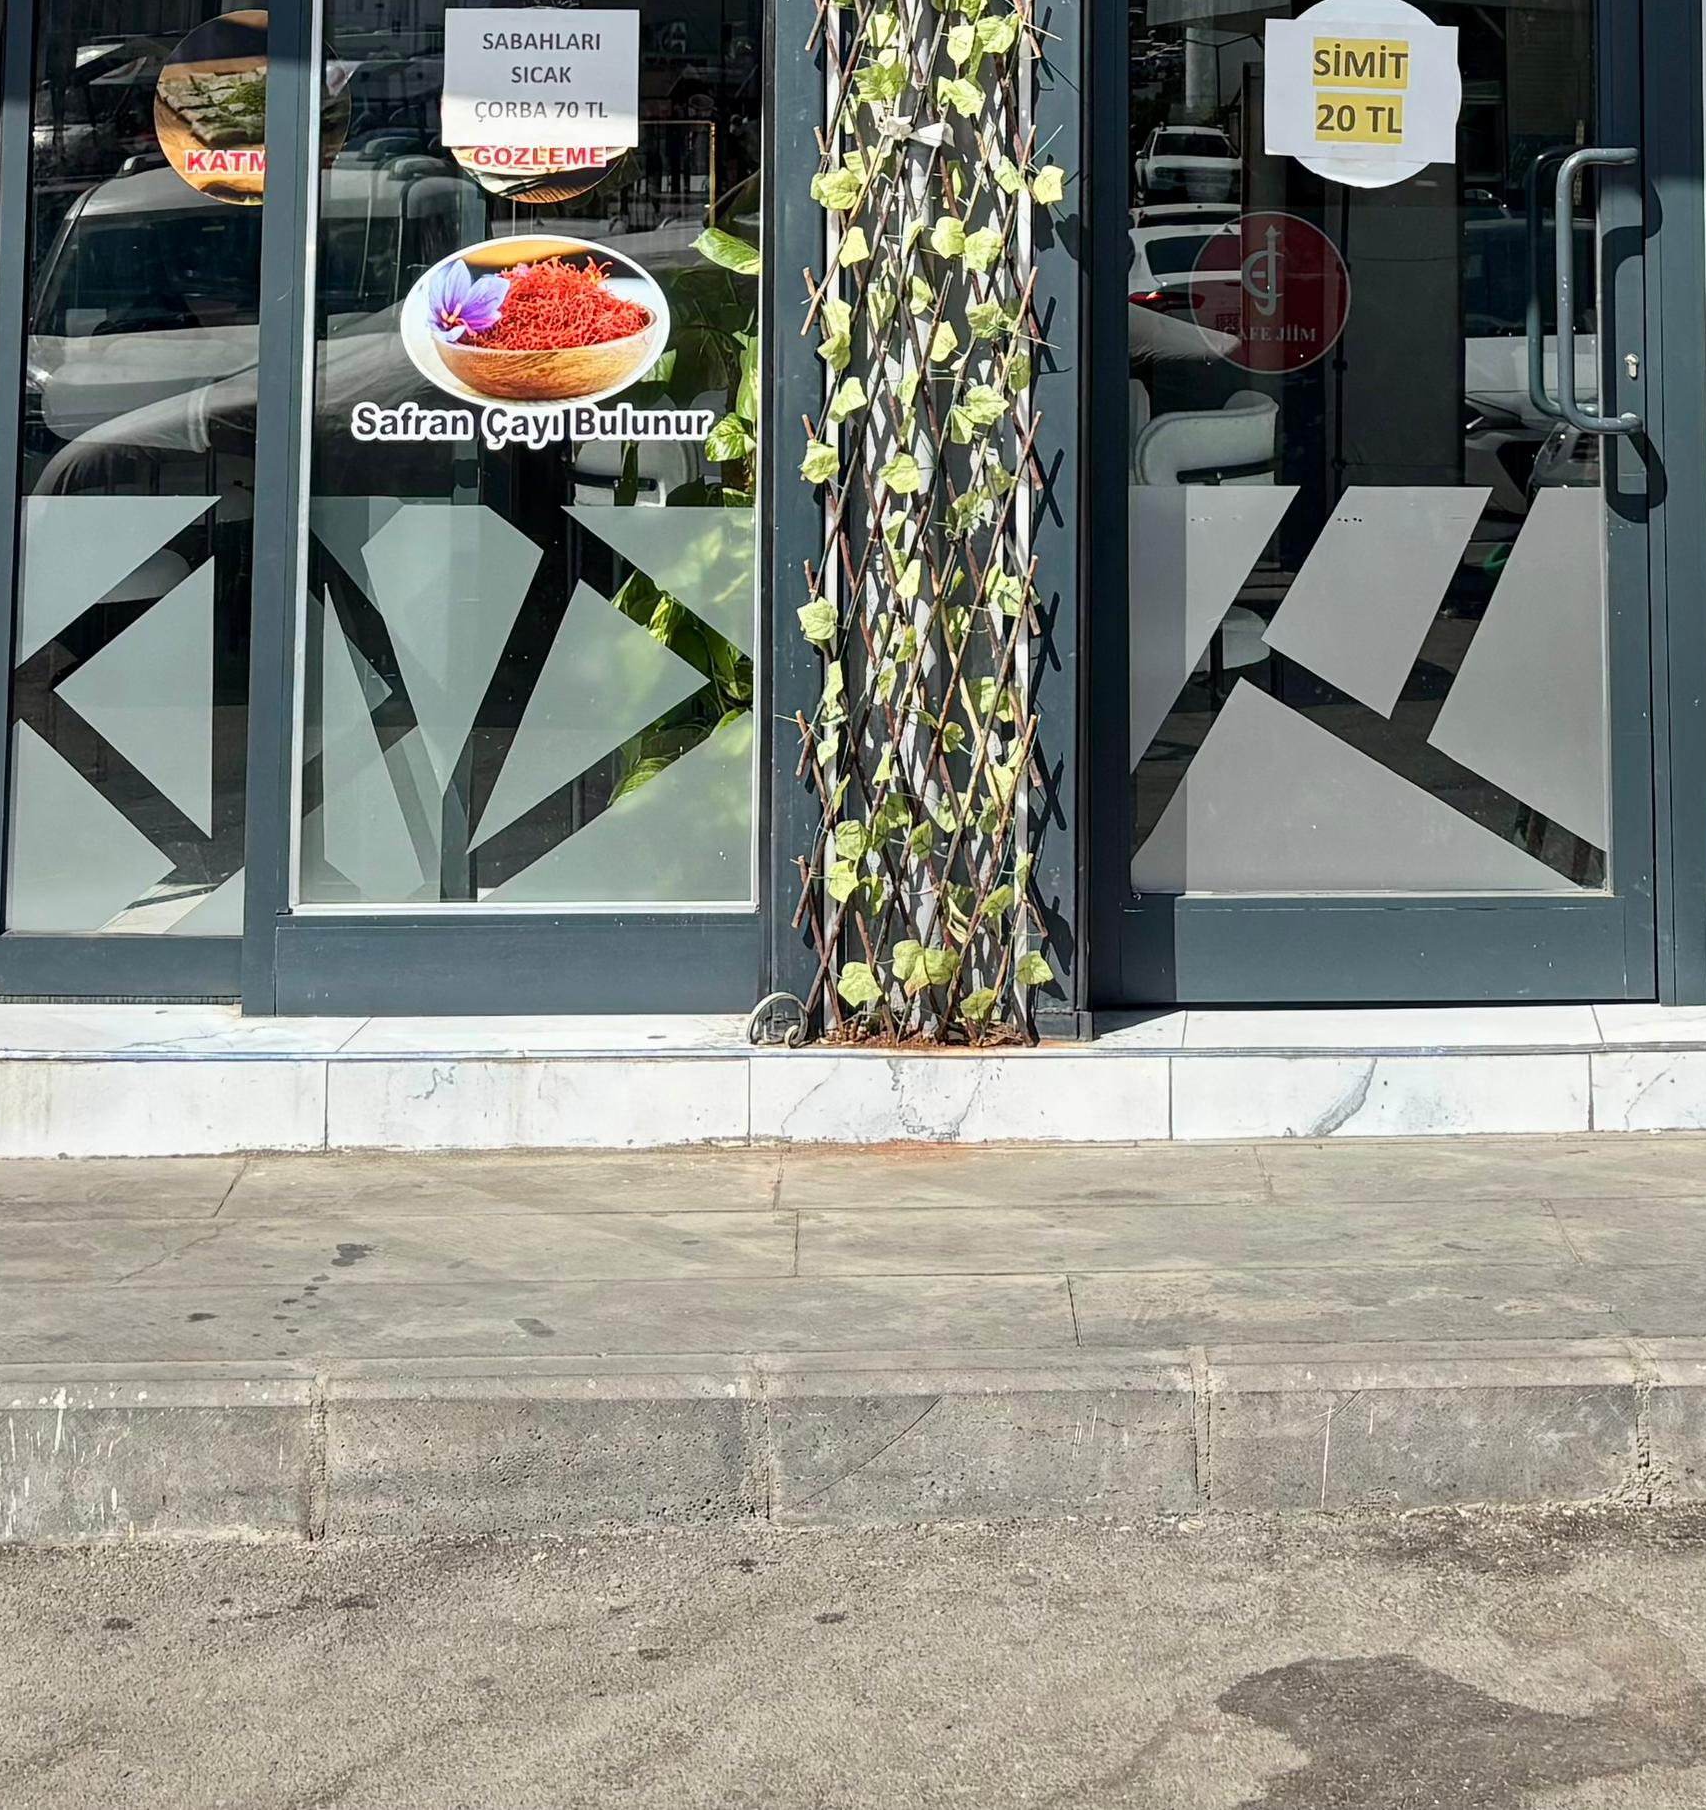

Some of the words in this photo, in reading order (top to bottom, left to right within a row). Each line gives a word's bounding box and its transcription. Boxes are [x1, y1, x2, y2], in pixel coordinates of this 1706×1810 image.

[482, 32, 602, 53] SABAHLARI
[1313, 43, 1409, 79] SİMİT
[510, 65, 572, 85] SICAK
[474, 100, 547, 124] ÇORBA
[555, 100, 579, 120] 70
[586, 100, 609, 120] TL
[1316, 104, 1355, 133] 20
[1366, 106, 1403, 134] TL
[186, 151, 266, 172] KATM
[353, 406, 471, 439] Safran
[485, 406, 563, 447] Çayı
[575, 407, 712, 439] Bulunur
